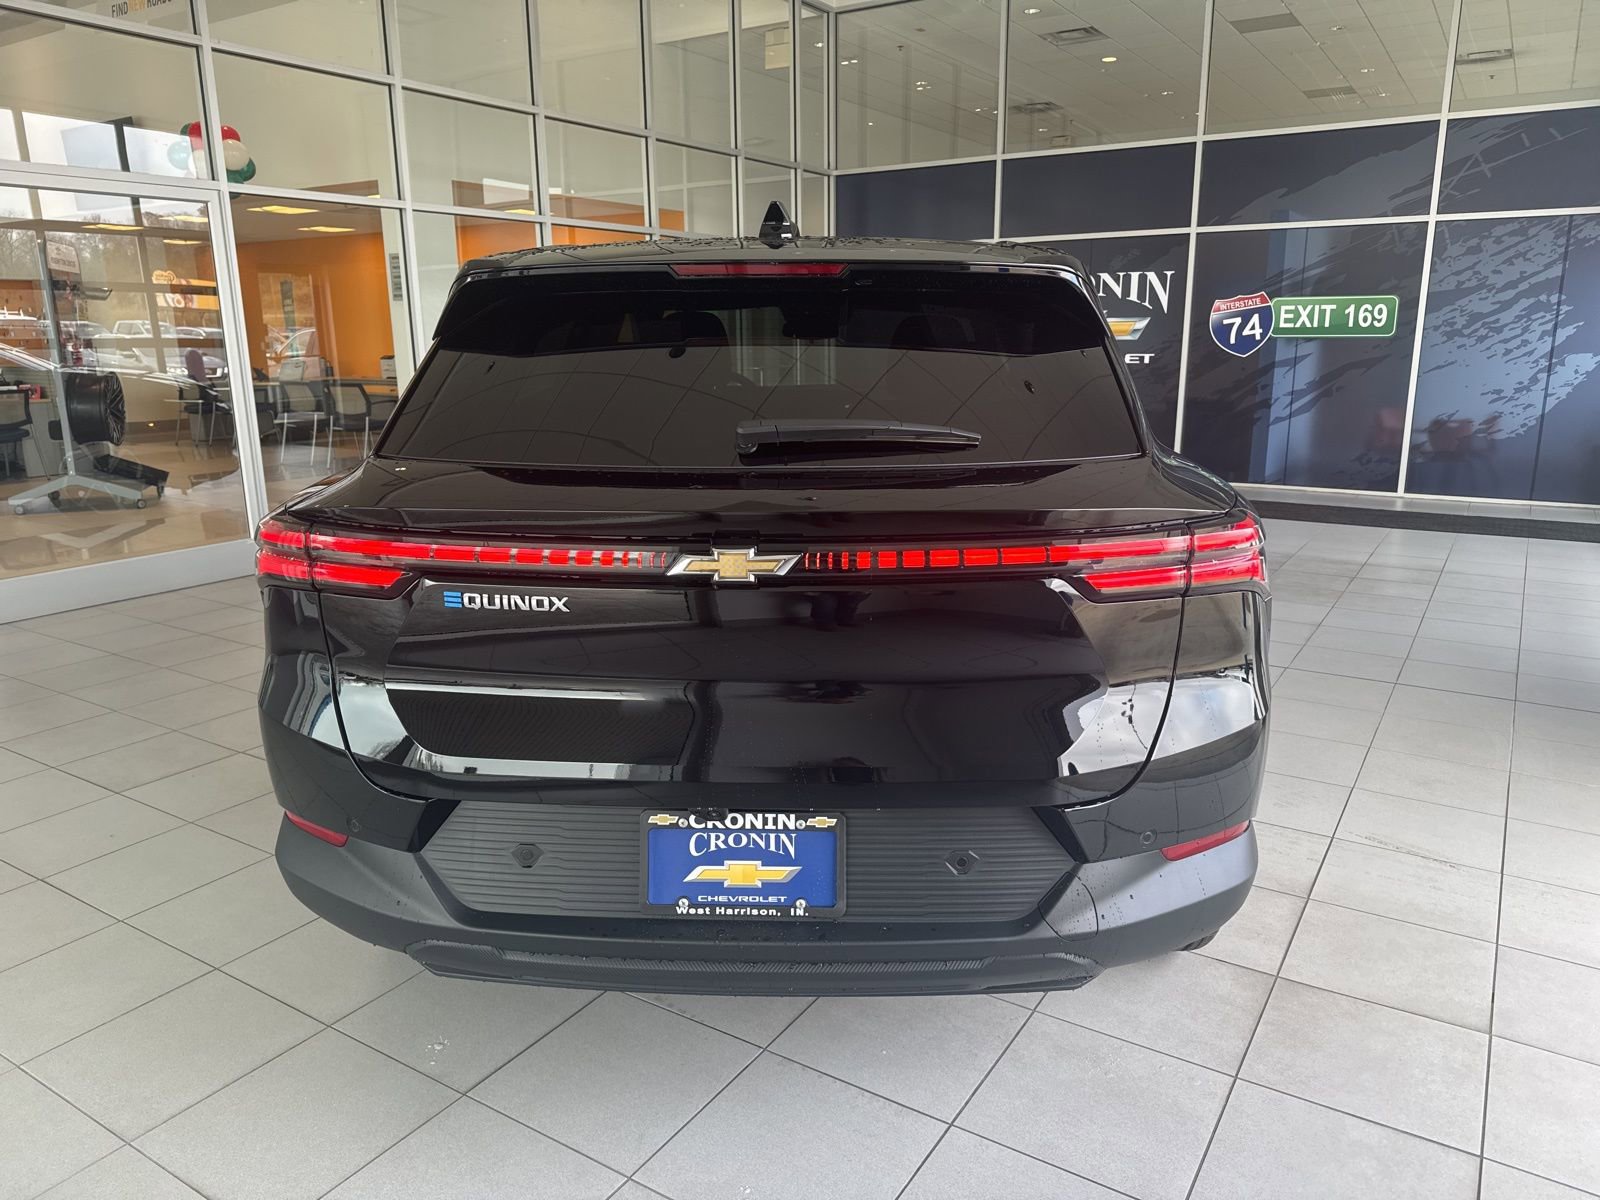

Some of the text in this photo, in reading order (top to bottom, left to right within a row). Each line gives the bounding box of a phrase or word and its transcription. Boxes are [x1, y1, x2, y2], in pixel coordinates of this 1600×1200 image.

[111, 1, 128, 18] FIND
[1090, 271, 1175, 314] NIN
[1219, 297, 1262, 311] INTERSTATE
[1279, 303, 1388, 328] EXIT 169
[1222, 313, 1264, 345] 74
[443, 591, 570, 612] EQUINOX
[689, 832, 797, 860] CRONIN
[697, 895, 787, 903] CHEVROLET
[675, 906, 711, 915] West
[715, 906, 781, 917] Harrison,
